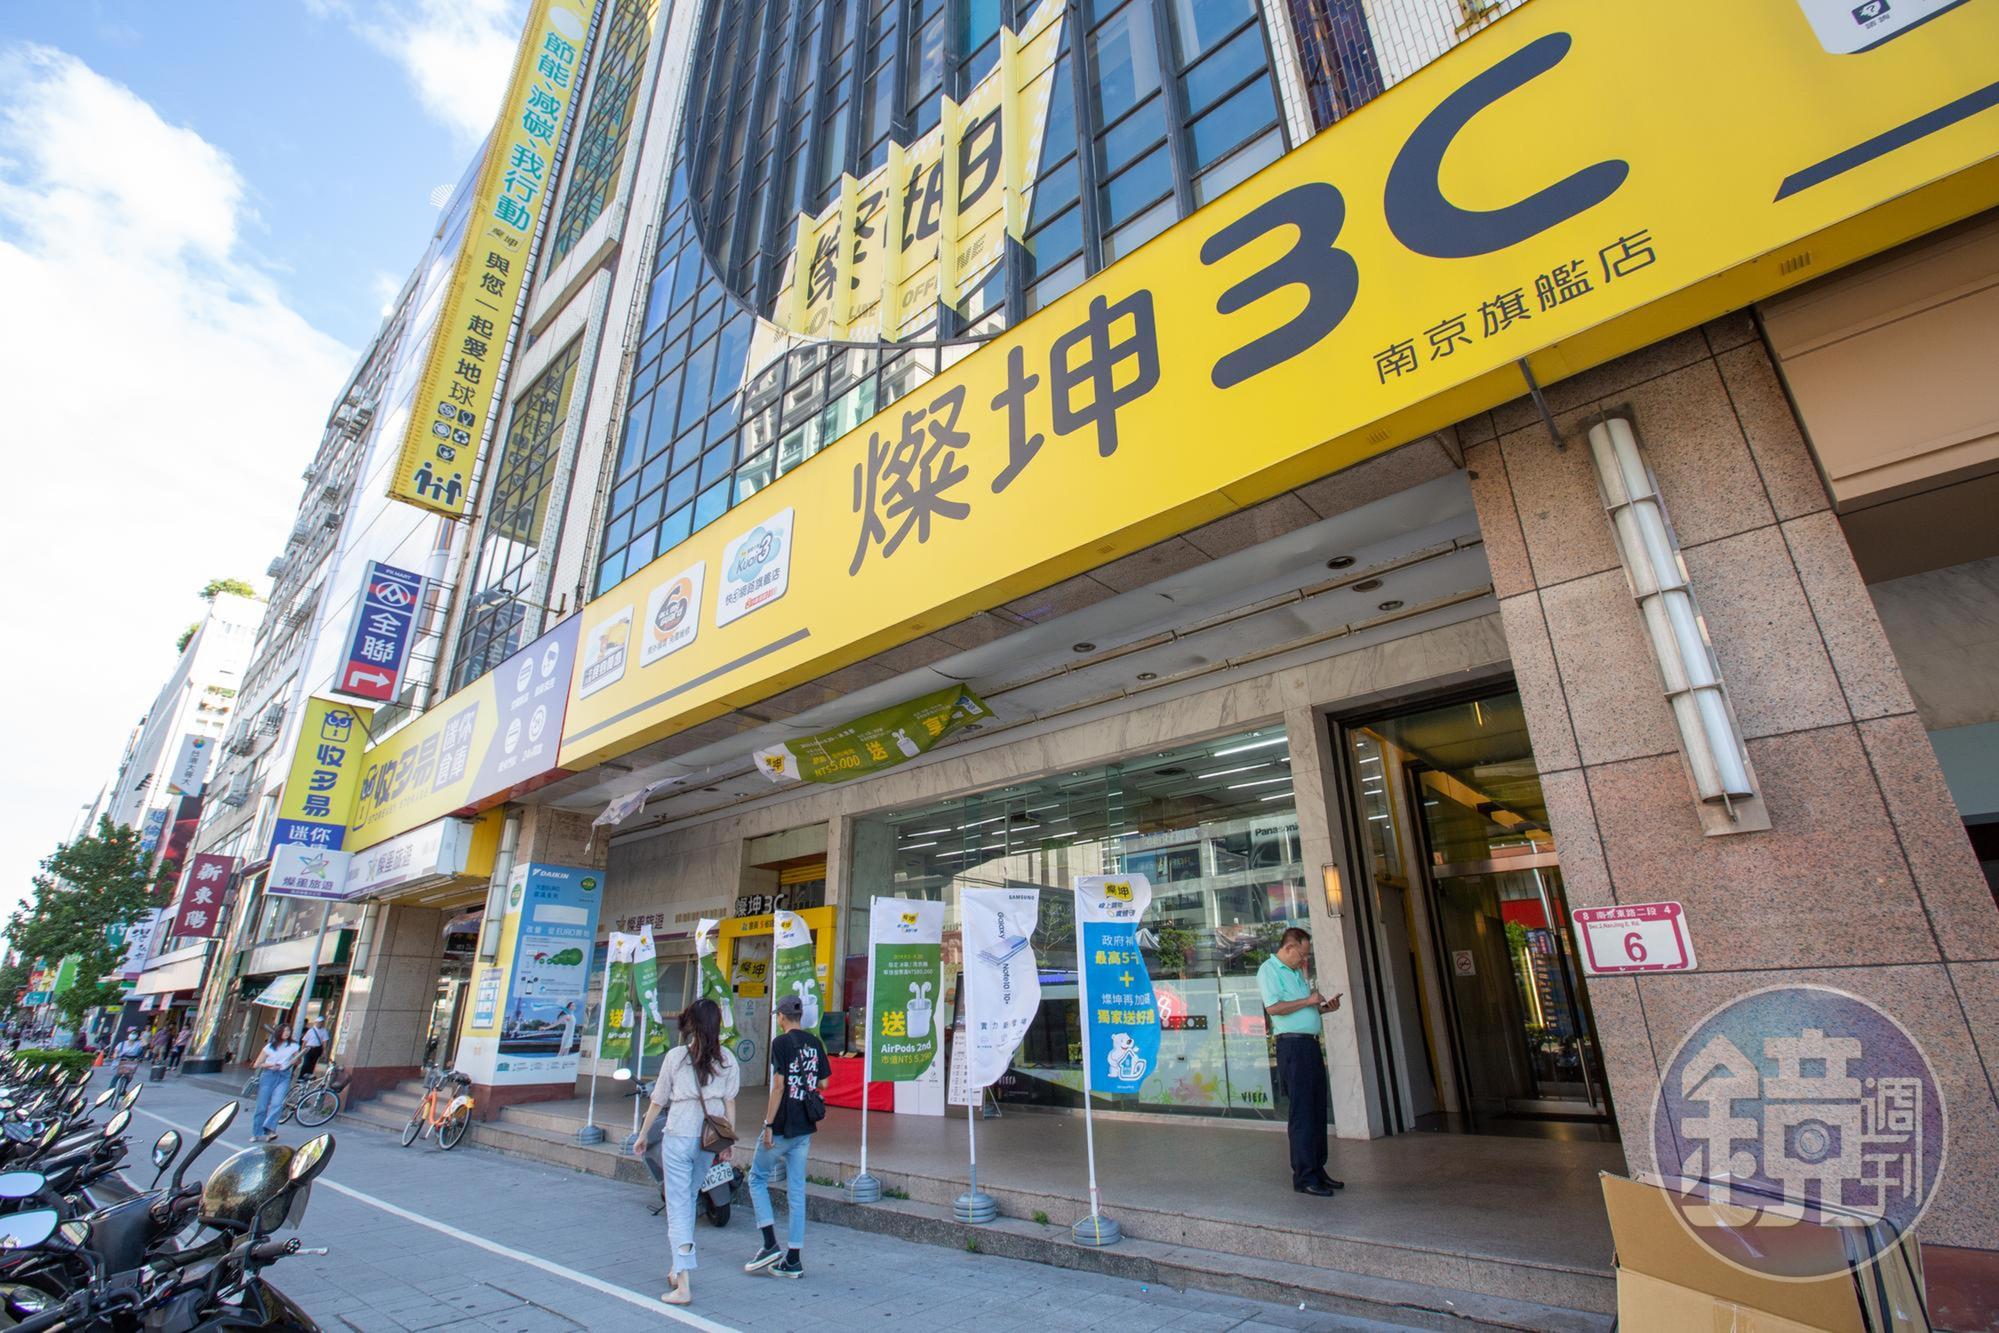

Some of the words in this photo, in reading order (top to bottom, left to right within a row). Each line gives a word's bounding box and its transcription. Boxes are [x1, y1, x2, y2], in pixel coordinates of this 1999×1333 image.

[849, 31, 1629, 577] 燦坤3C
[1374, 229, 1656, 384] 南京旗艦店
[448, 251, 510, 407] 與您一起愛地球
[361, 612, 401, 662] 全聯
[302, 743, 346, 817] 收多易
[374, 731, 440, 809] 收多易
[288, 825, 332, 842] 迷你
[283, 876, 334, 891] 燦星旅遊
[540, 870, 570, 879] DAIKIN
[184, 862, 223, 929] 新東陽
[1106, 884, 1129, 898] 燦坤
[997, 912, 1005, 938] Galaxy
[1583, 911, 1589, 920] 8
[1664, 905, 1671, 914] 4
[1624, 932, 1647, 962] 6
[881, 1010, 906, 1038] 送
[881, 1044, 915, 1054] AirPods
[917, 1039, 932, 1051] 2nd
